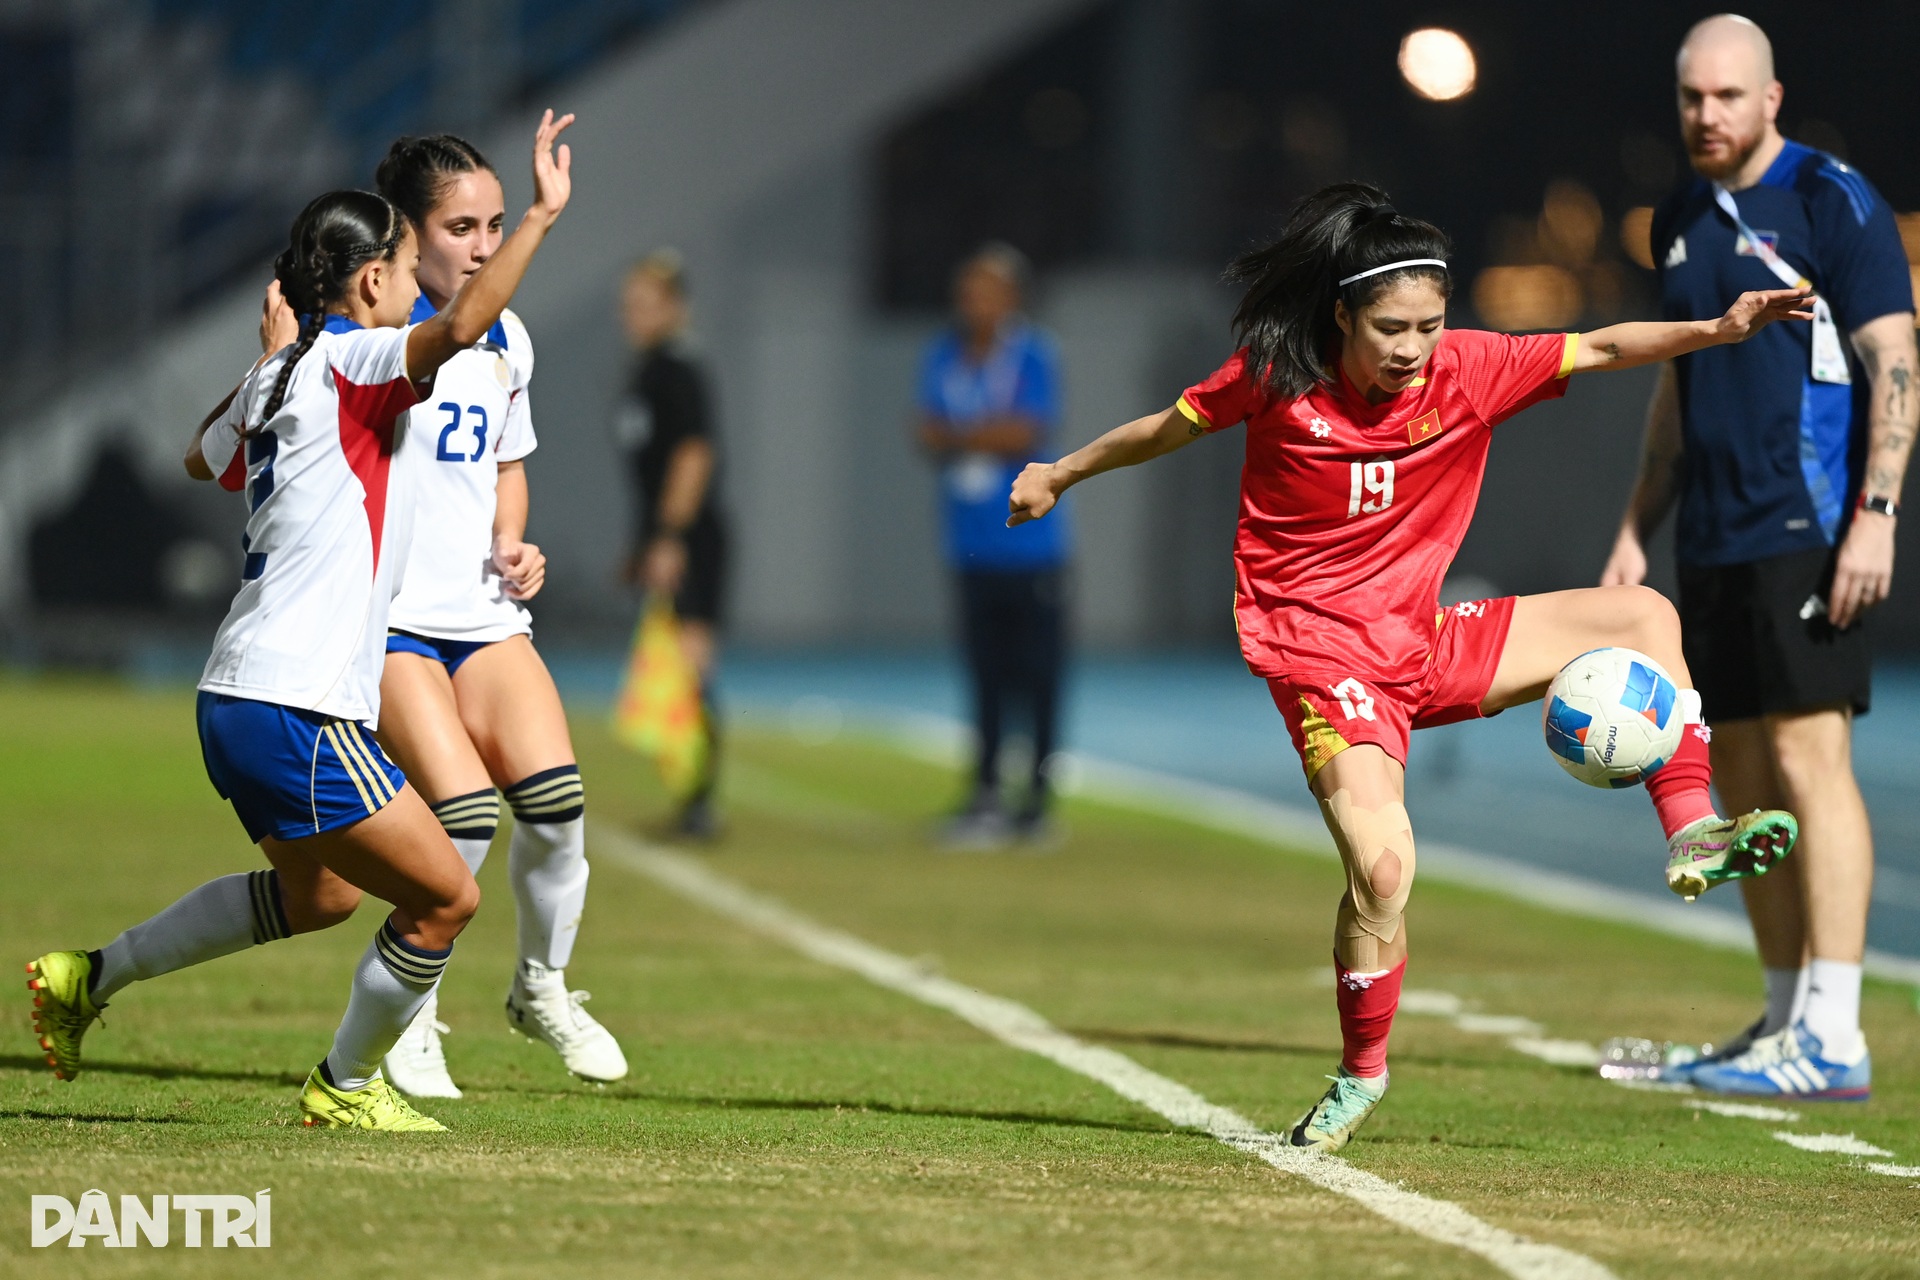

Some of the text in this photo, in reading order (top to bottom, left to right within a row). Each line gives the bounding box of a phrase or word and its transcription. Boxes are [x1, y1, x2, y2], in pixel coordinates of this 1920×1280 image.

[436, 401, 488, 462] 23
[1347, 454, 1395, 519] 19
[1603, 725, 1618, 764] molten
